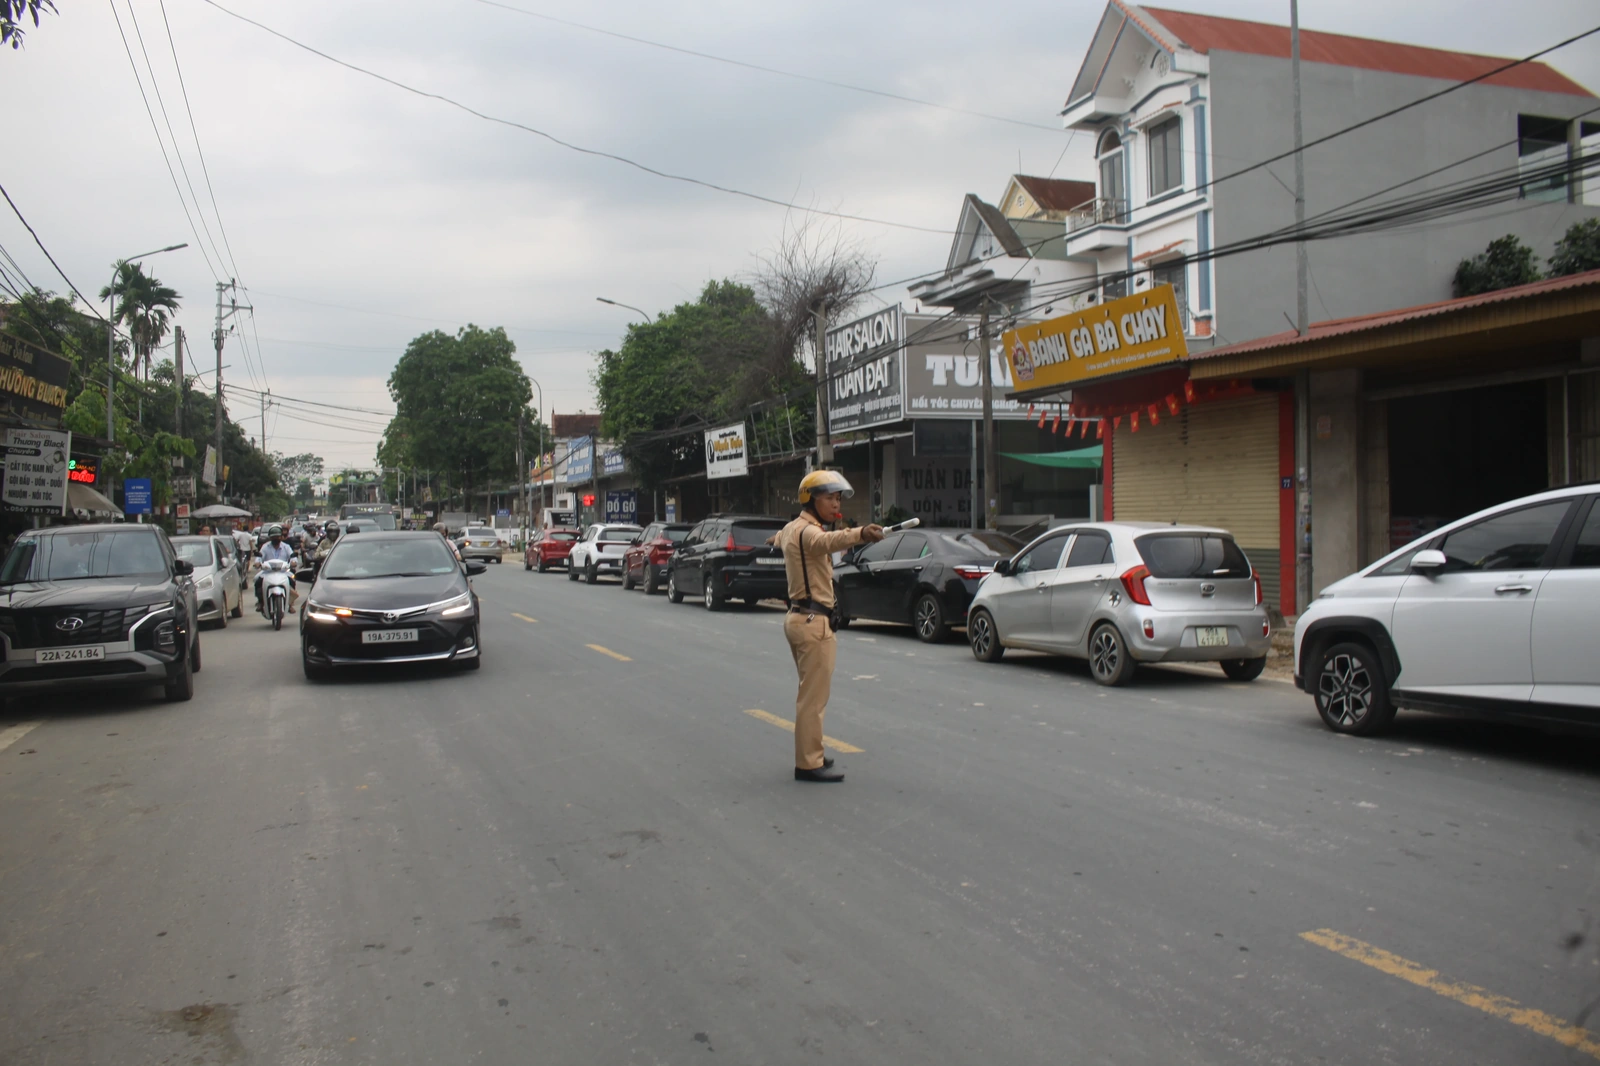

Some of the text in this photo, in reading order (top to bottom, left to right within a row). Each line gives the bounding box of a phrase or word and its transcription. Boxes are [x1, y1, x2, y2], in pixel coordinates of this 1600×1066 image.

[828, 310, 896, 362] HAIR SALON
[1028, 298, 1168, 368] BÁNH GÀ BÁ CHÁY
[833, 355, 892, 400] TUẤN ĐẠT
[36, 380, 68, 409] BLACK
[912, 394, 928, 408] NỐI
[930, 396, 948, 408] TÓC
[43, 440, 65, 449] Black
[368, 631, 413, 641] 19A-375.91
[42, 648, 99, 661] 22A-241.84
